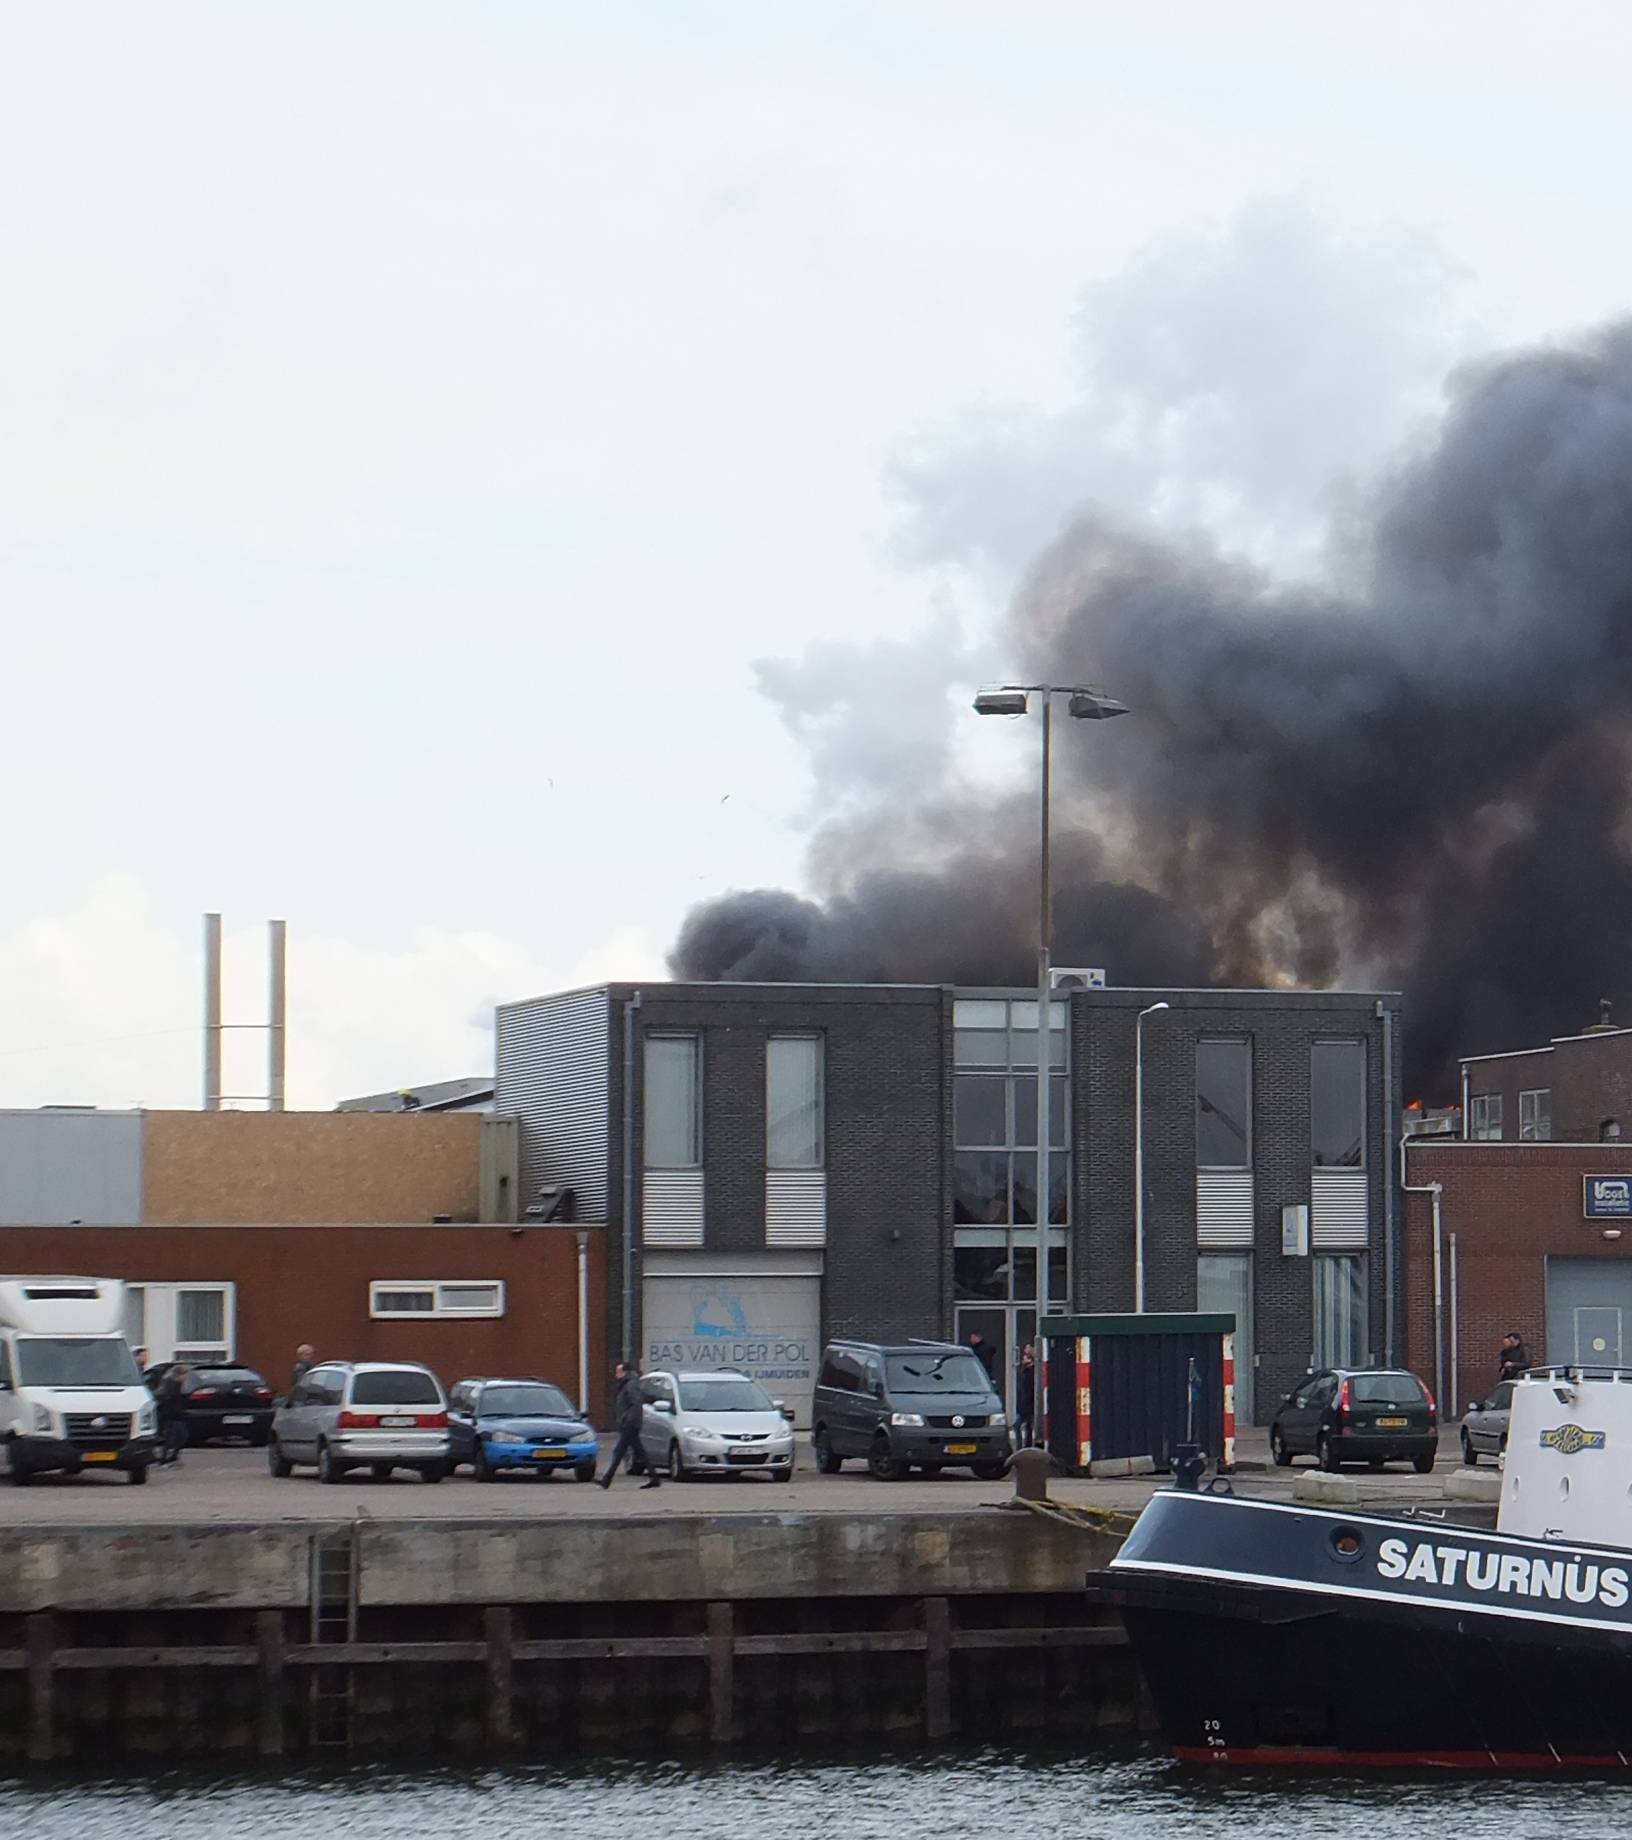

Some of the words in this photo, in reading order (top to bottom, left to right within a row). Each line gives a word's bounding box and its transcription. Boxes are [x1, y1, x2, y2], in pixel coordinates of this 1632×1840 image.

[650, 1344, 683, 1362] BAS
[687, 1344, 727, 1362] VAN
[732, 1343, 769, 1362] DER
[774, 1343, 810, 1362] POL
[1377, 1538, 1629, 1608] SATURNUS
[1203, 1719, 1220, 1730] 20
